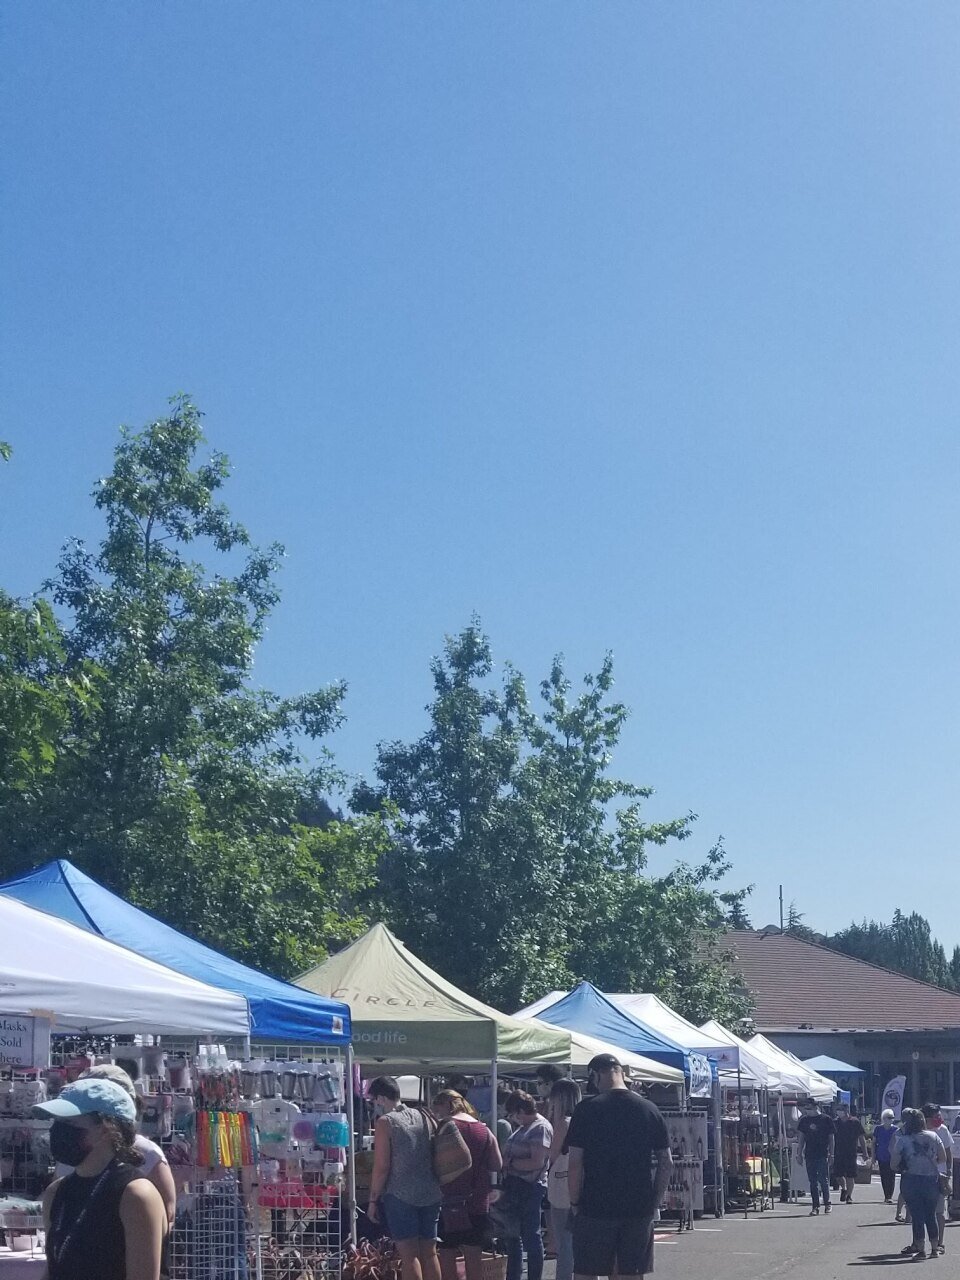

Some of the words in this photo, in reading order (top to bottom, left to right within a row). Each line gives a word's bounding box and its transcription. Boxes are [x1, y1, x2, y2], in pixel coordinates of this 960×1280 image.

[330, 987, 437, 1008] CIRCLE
[0, 1036, 22, 1048] Sold
[351, 1031, 382, 1043] ood
[384, 1031, 408, 1044] life
[0, 1052, 23, 1064] here
